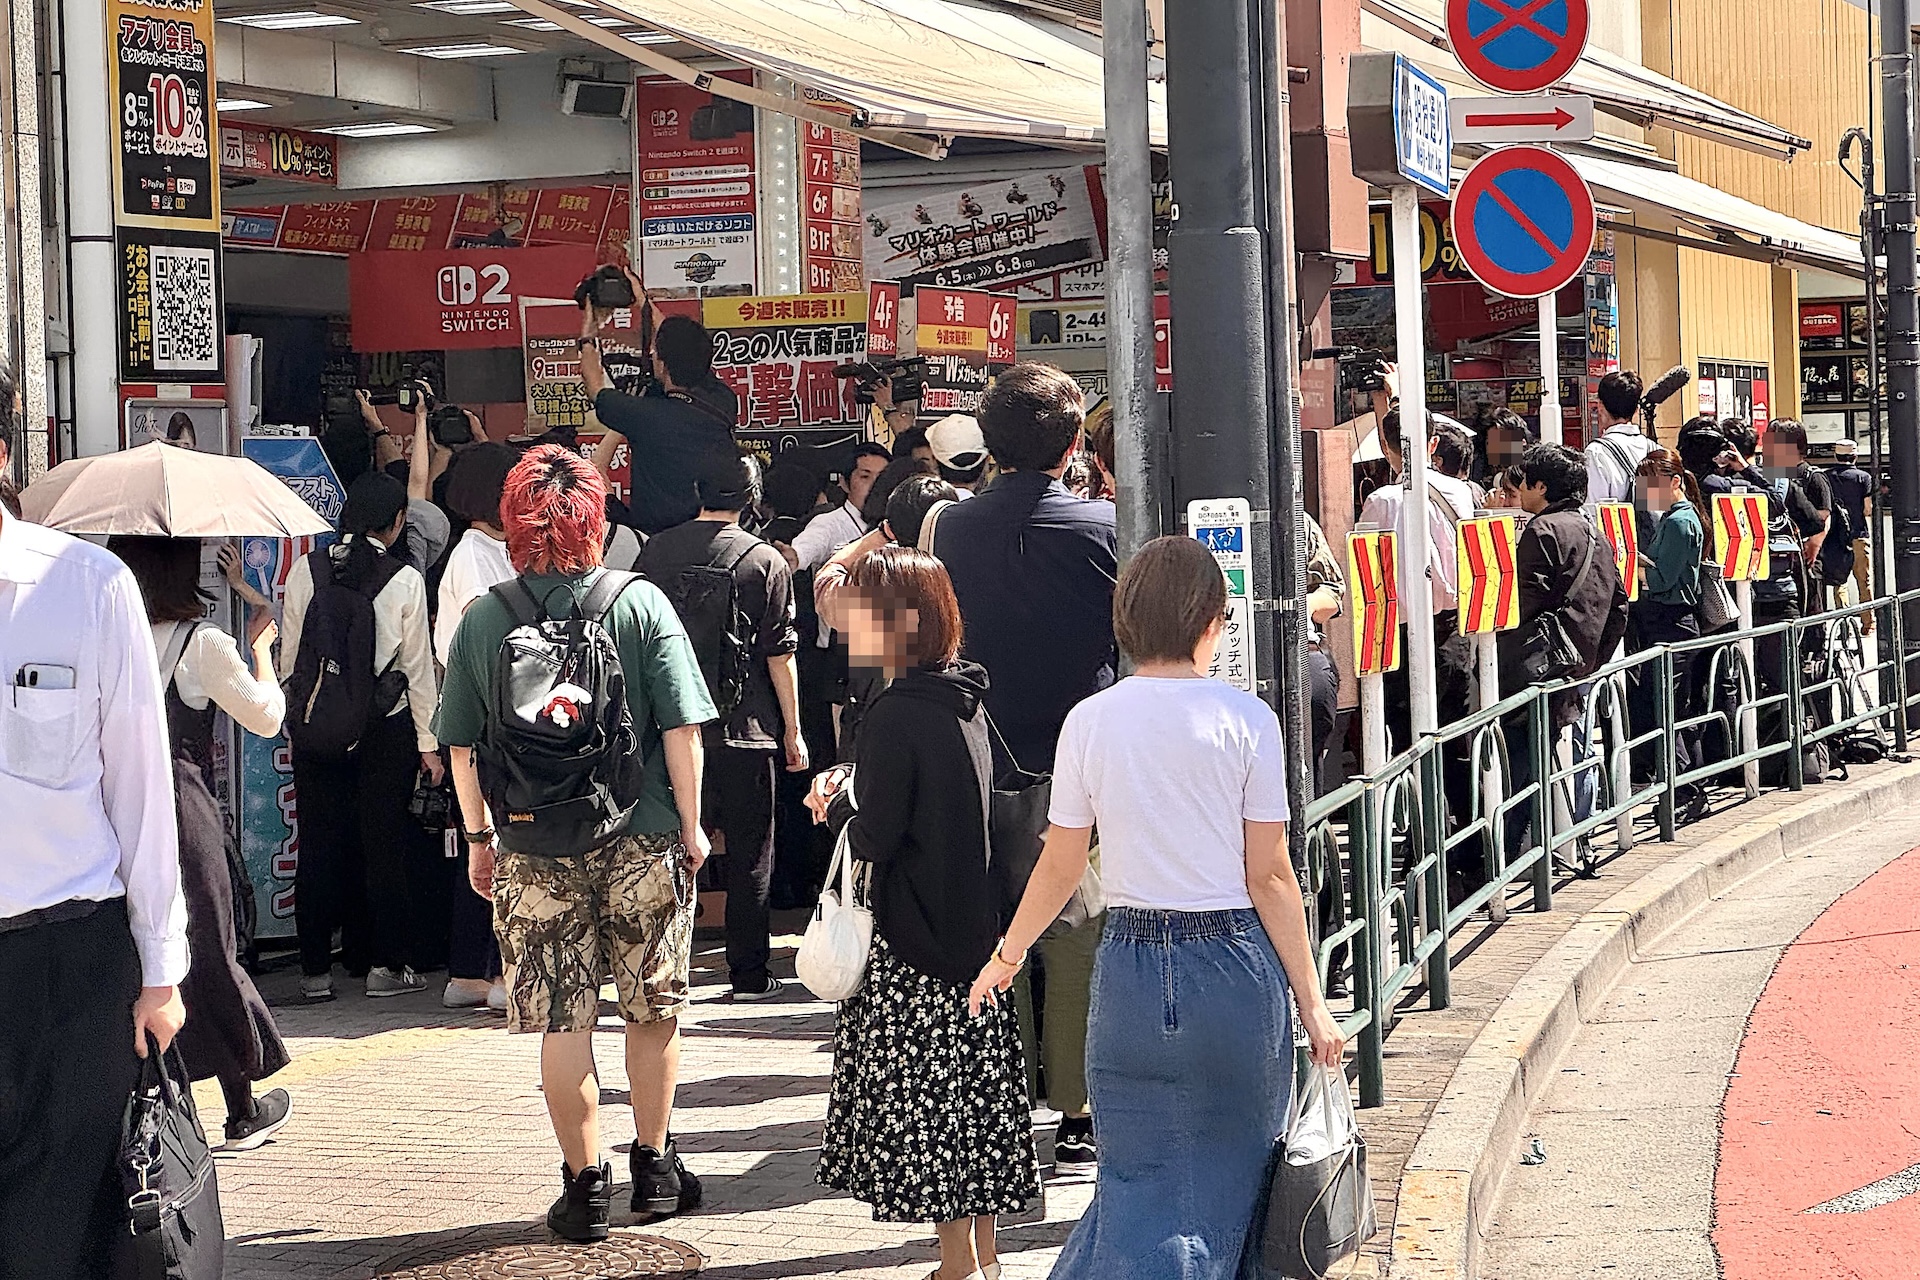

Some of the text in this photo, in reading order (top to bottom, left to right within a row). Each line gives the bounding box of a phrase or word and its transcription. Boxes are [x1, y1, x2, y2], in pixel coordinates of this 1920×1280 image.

[149, 76, 203, 139] 10%
[124, 129, 151, 143] ポイント
[125, 142, 152, 155] サービス
[155, 138, 206, 155] ポイントサービス
[269, 132, 301, 171] 10%
[304, 144, 331, 160] ポイント
[648, 150, 681, 159] Nintendo
[682, 148, 707, 158] Switch
[305, 160, 333, 177] サービス
[812, 152, 828, 177] 7F
[812, 189, 827, 214] 6F
[647, 218, 752, 234] ご体験いただけるソフト
[809, 226, 830, 251] B1F
[889, 203, 1058, 253] マリオカート ワールド
[919, 225, 1035, 266] 体験会開催中!
[479, 263, 512, 305] 2
[810, 263, 831, 288] B1F
[136, 244, 151, 362] お会計前に
[441, 309, 509, 319] NINTENDO
[738, 299, 846, 321] 今週末販売!!
[873, 290, 893, 329] 4F
[943, 295, 965, 323] 予告
[441, 317, 510, 333] SWITCH
[989, 301, 1010, 340] 6F
[1802, 317, 1838, 326] OUTBACK
[936, 329, 973, 346] 今週末販売!!
[1513, 514, 1528, 531] 赤
[1227, 622, 1243, 678] タッチ式
